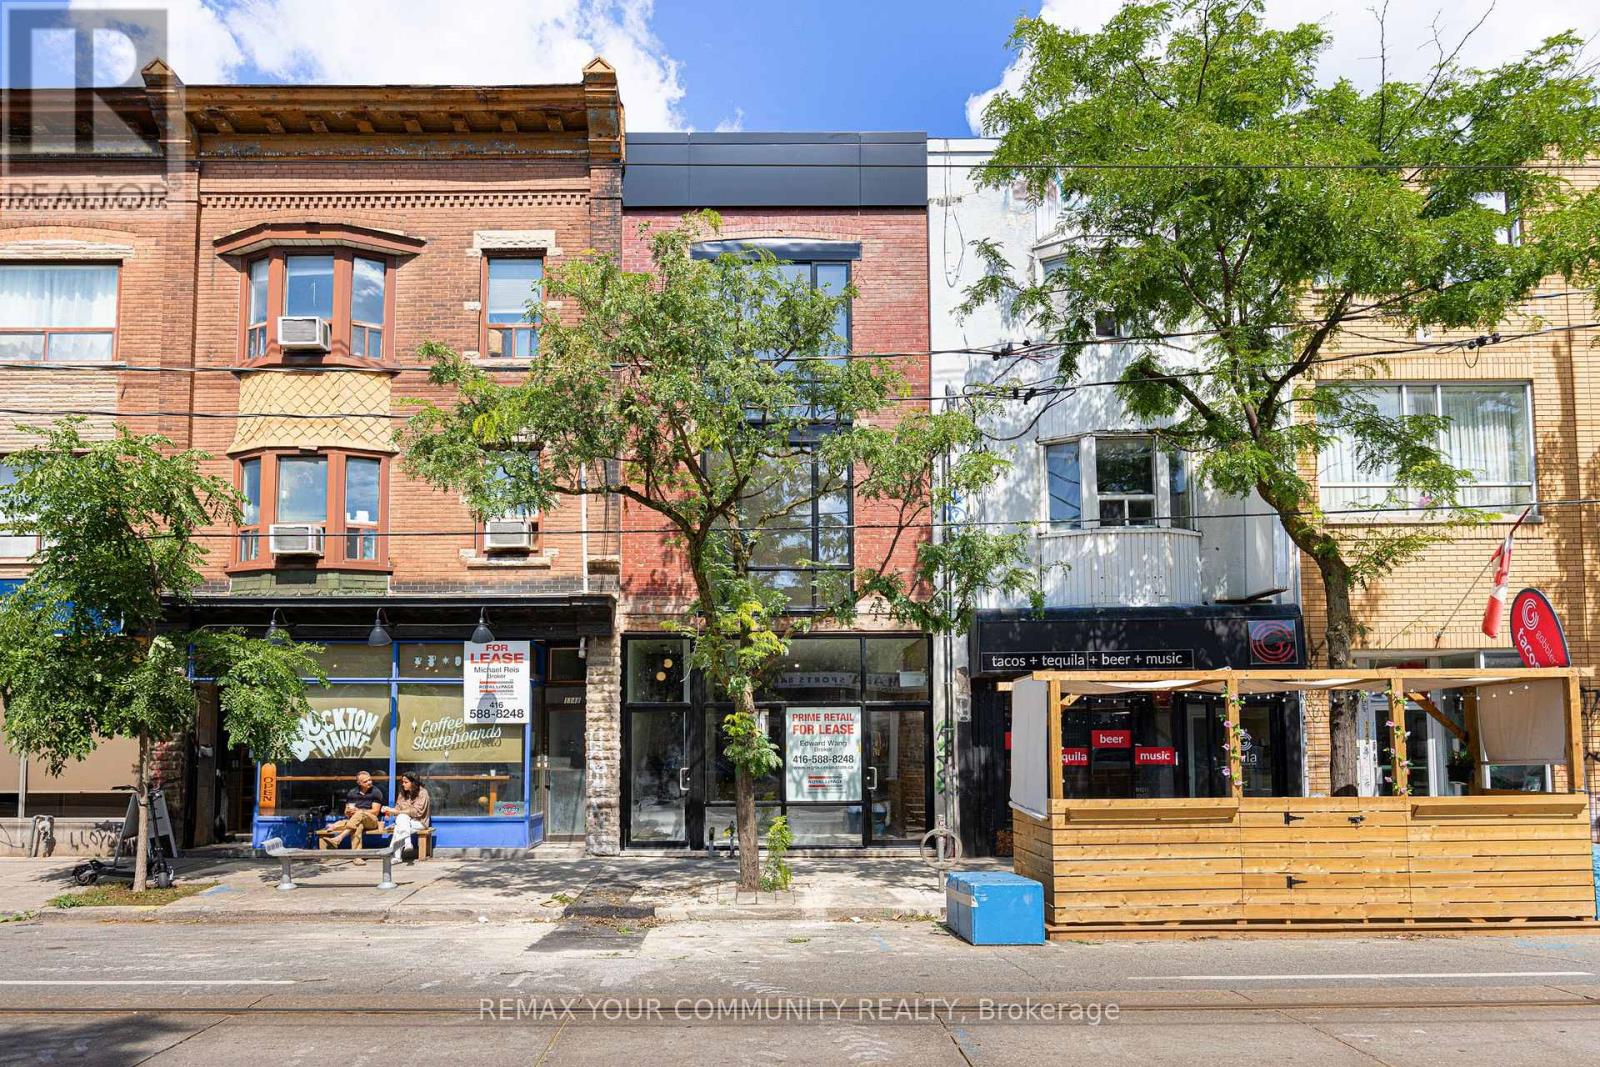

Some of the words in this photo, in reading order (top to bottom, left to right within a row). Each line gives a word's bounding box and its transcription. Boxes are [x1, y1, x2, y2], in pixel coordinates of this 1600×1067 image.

[485, 644, 509, 652] FOR
[470, 653, 524, 664] LEASE
[992, 655, 1026, 667] tacos
[1042, 654, 1085, 669] tequila
[1102, 653, 1130, 665] beer
[1146, 652, 1183, 664] music
[469, 709, 524, 719] 588-8248
[792, 713, 821, 722] PRIME
[823, 713, 854, 721] RETAIL
[421, 716, 464, 734] Coffee
[792, 724, 815, 735] FOR
[819, 724, 854, 735] LEASE
[412, 724, 502, 750] Skateboards
[1100, 734, 1124, 744] beer
[792, 755, 854, 763] 416-588-8248
[1140, 751, 1170, 760] music
